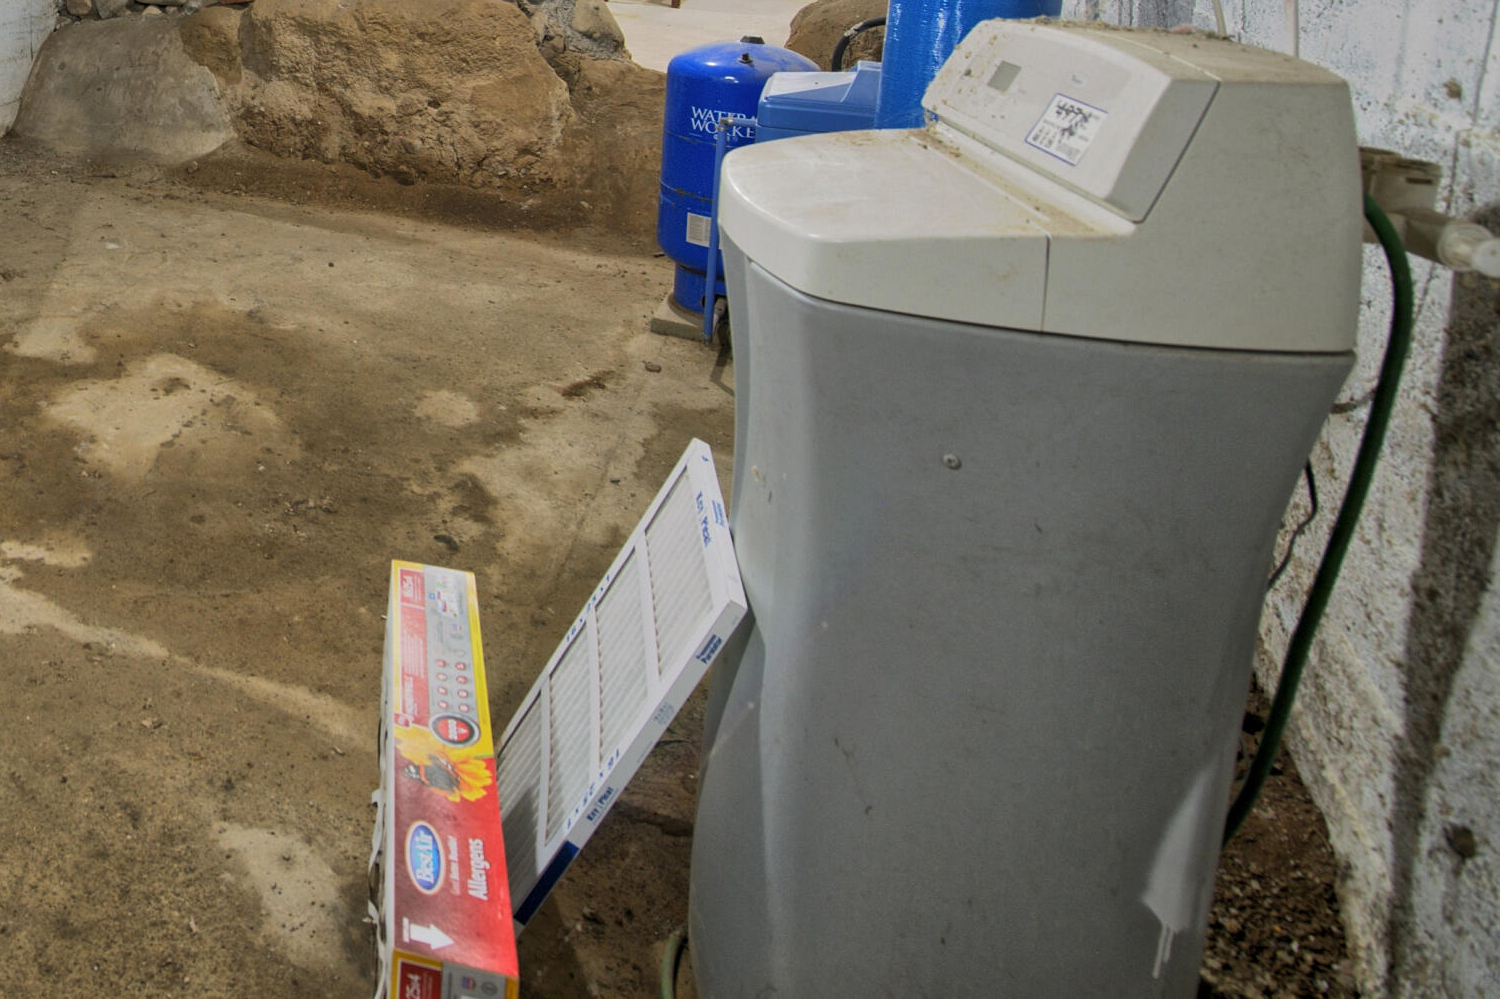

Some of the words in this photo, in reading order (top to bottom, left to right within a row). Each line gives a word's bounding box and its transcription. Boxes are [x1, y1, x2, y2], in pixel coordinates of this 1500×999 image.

[585, 806, 601, 822] Key
[416, 830, 435, 884] BestAir
[466, 838, 489, 901] Allergens
